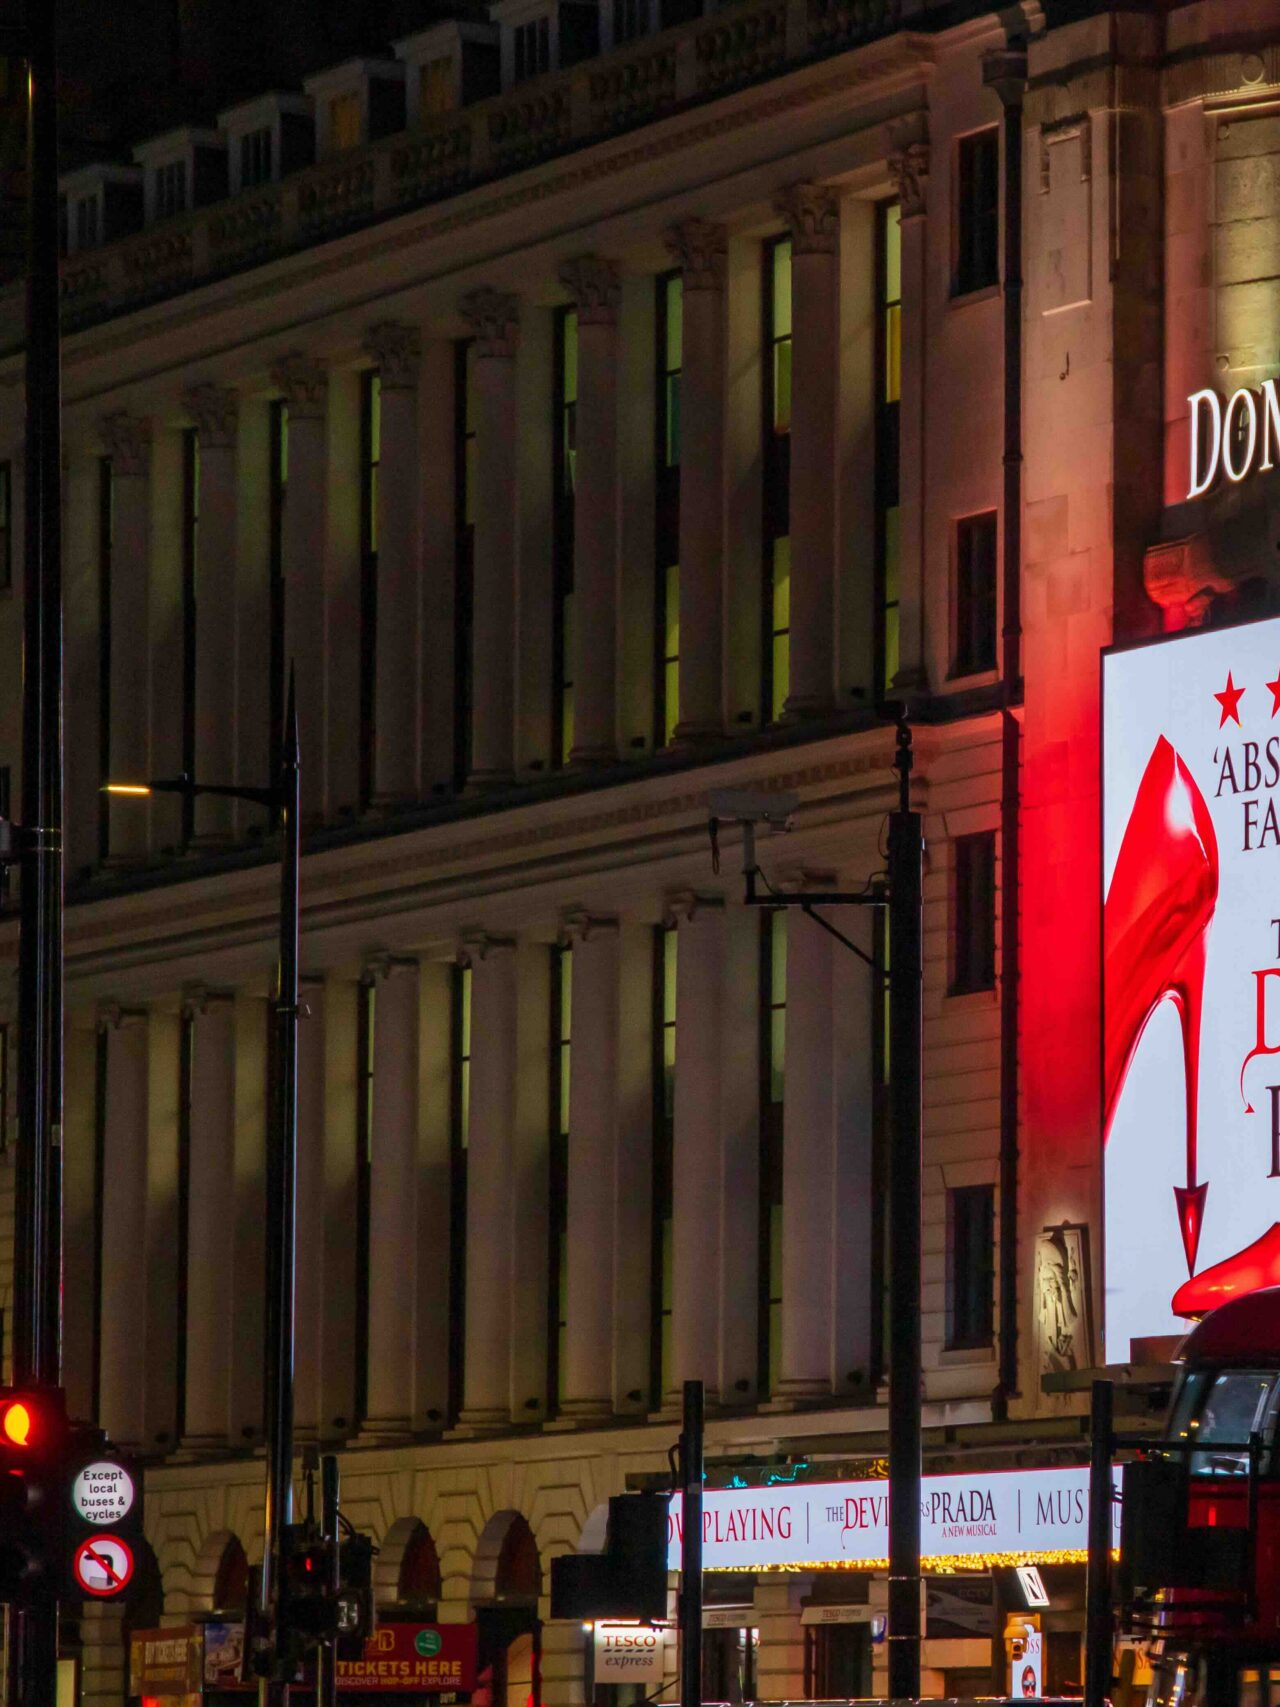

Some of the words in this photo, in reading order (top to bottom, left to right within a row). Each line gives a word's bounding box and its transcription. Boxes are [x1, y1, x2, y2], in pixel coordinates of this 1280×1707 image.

[83, 1470, 123, 1482] Except
[89, 1483, 117, 1493] local
[81, 1497, 115, 1507] buses
[118, 1496, 125, 1506] &
[85, 1509, 121, 1520] cycles
[826, 1505, 844, 1523] THE
[844, 1496, 889, 1530] DEVI
[930, 1488, 997, 1525] PRADA
[703, 1506, 791, 1543] PLAYING
[942, 1527, 947, 1538] A
[948, 1525, 965, 1537] NEW
[966, 1523, 998, 1537] MUSICAL
[603, 1635, 656, 1648] TESCO
[337, 1661, 409, 1676] TICKETS
[415, 1661, 462, 1676] HERE
[604, 1654, 655, 1670] express
[421, 1677, 462, 1686] EXPLORE
